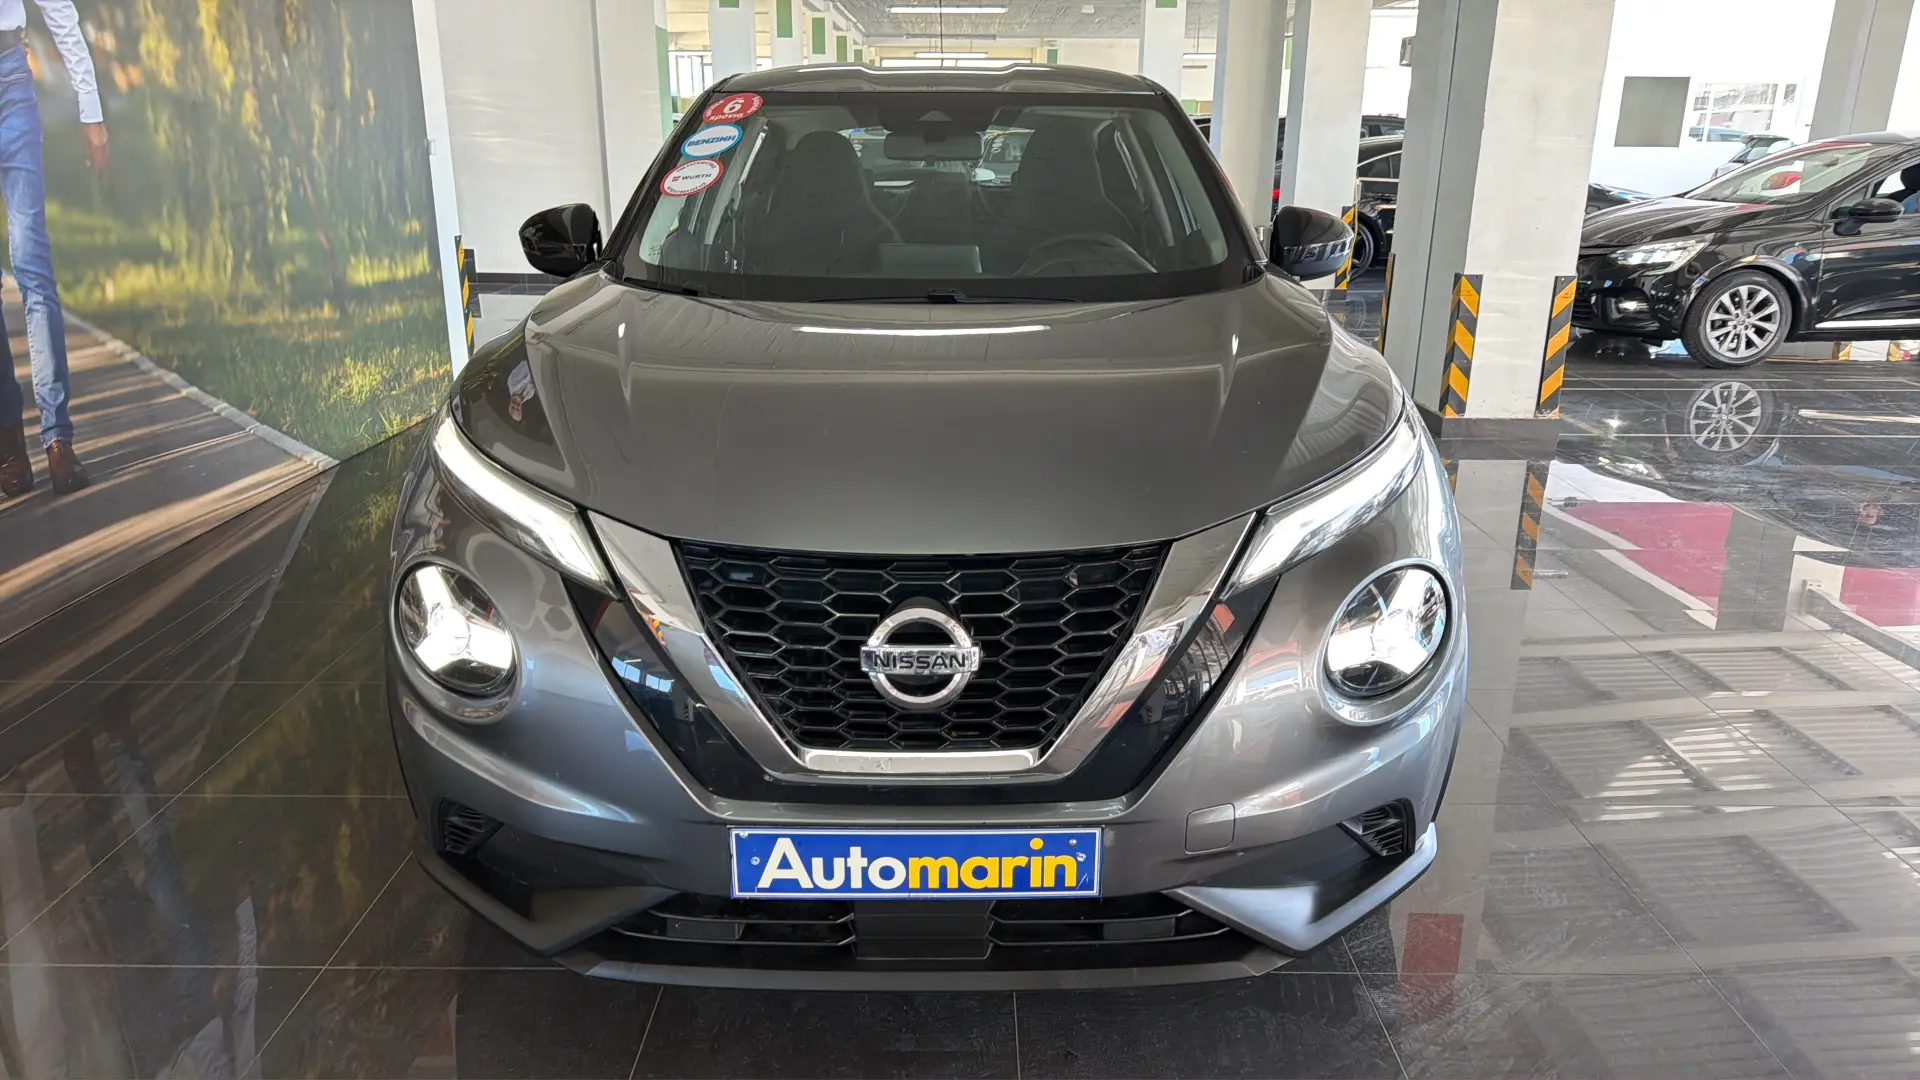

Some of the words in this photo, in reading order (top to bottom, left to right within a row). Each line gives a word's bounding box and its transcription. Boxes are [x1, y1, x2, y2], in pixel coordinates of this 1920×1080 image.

[723, 99, 744, 114] 6
[873, 652, 966, 669] NISSAN
[757, 837, 1078, 889] Automarin
